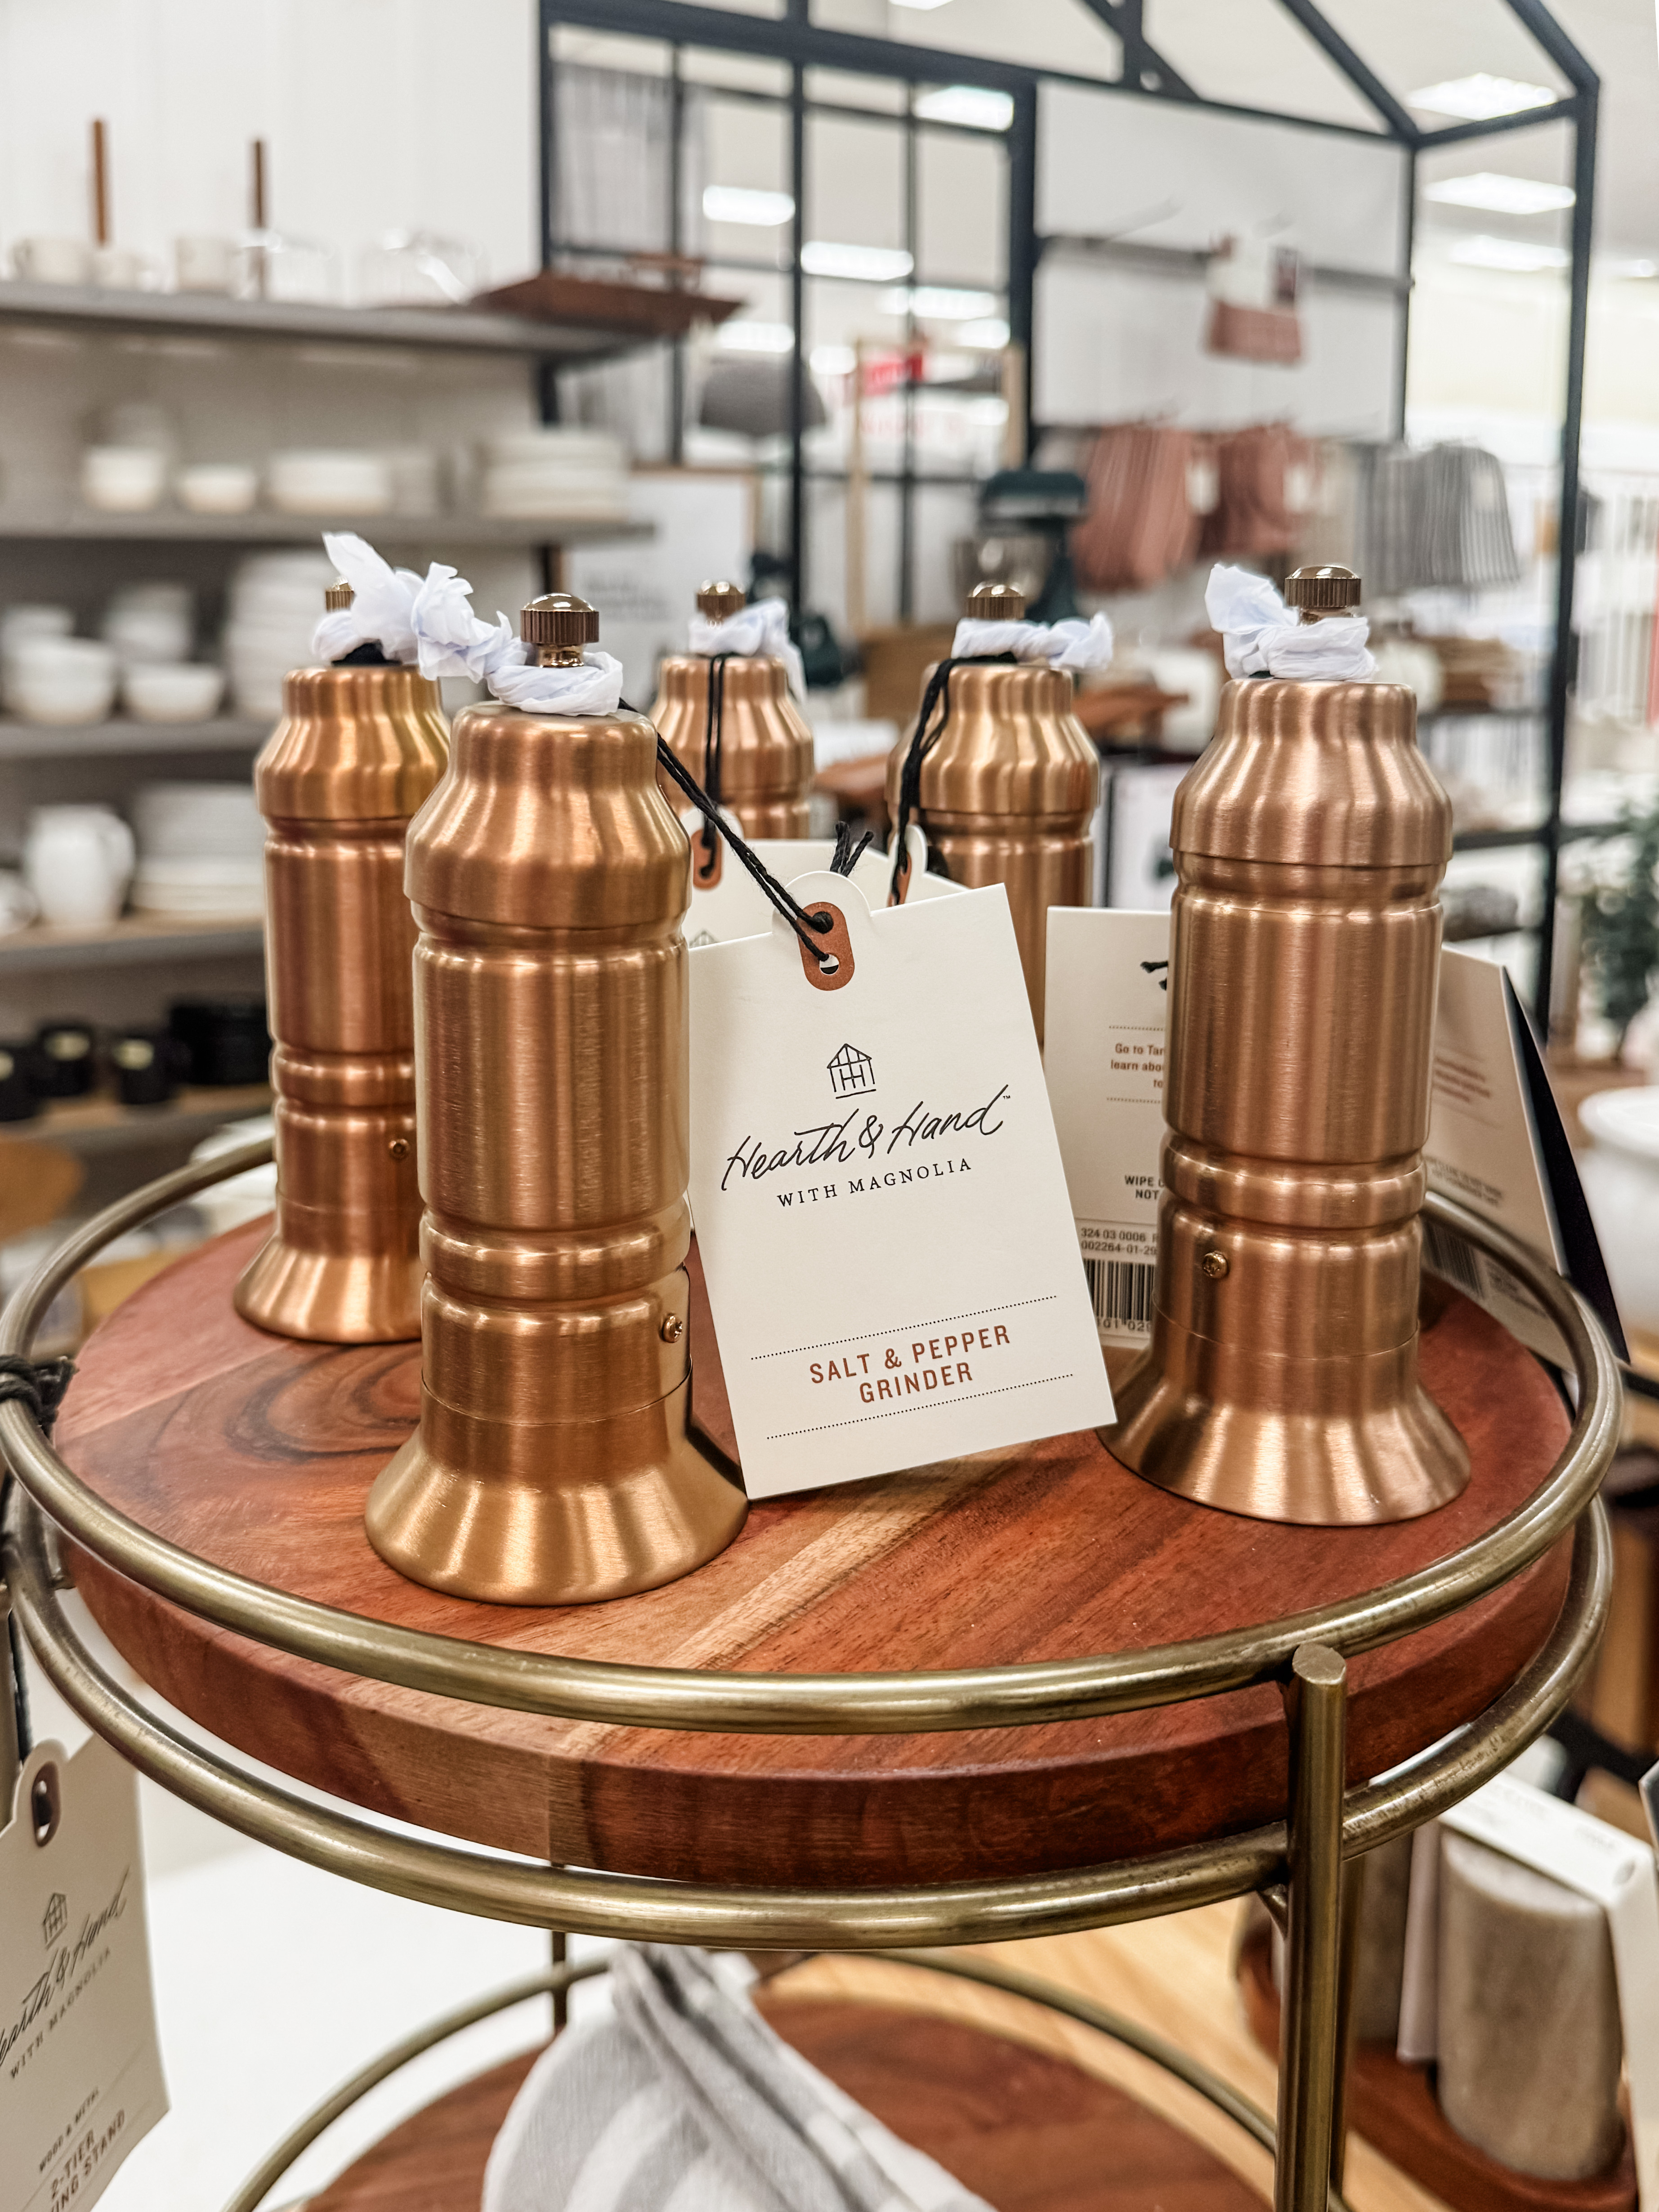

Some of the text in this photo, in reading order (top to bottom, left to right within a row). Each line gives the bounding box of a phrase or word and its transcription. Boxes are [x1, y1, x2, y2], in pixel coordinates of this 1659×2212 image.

[1111, 1059, 1138, 1070] learn
[1115, 1043, 1129, 1054] Go
[1133, 1045, 1144, 1054] to
[721, 1108, 859, 1191] Hearth
[859, 1115, 883, 1159] &
[777, 1158, 971, 1207] WITH MAGNOLIA
[1124, 1175, 1154, 1187] WIPE
[1135, 1189, 1159, 1200] NOT
[1081, 1228, 1100, 1238] 324
[1103, 1229, 1117, 1240] 03
[809, 1325, 1011, 1384] SALT & PEPPER
[859, 1362, 973, 1403] GRINDER
[0, 1948, 55, 2068] earth
[84, 2108, 125, 2177] STAND
